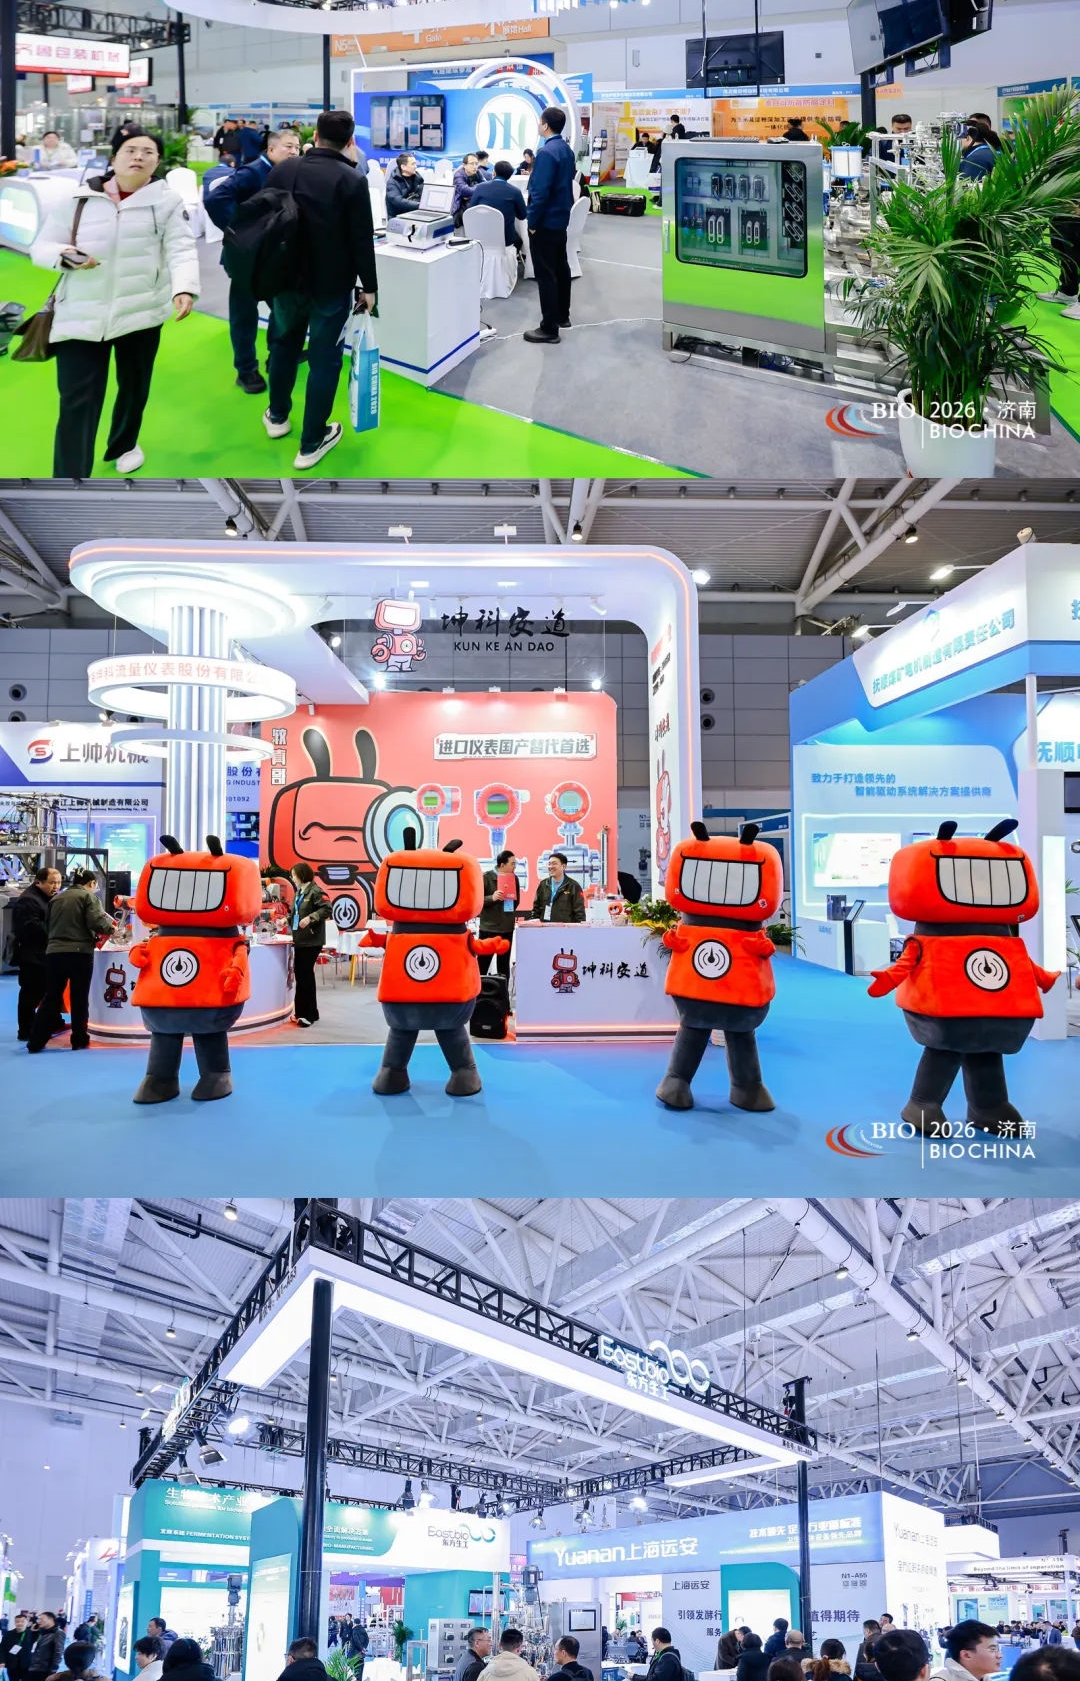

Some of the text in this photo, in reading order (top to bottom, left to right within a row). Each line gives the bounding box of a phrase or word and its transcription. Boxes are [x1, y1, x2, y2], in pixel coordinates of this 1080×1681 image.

[454, 641, 555, 652] KUN KE AN DAO
[438, 737, 591, 756] 进口仪表国产替代首选
[811, 773, 896, 784] 致力于打造领先的
[855, 786, 992, 798] 智能驱动系统解决方案提供商
[599, 1334, 670, 1384] Eastbio
[626, 1371, 670, 1402] 东方生工
[671, 1579, 710, 1591] 上海远安
